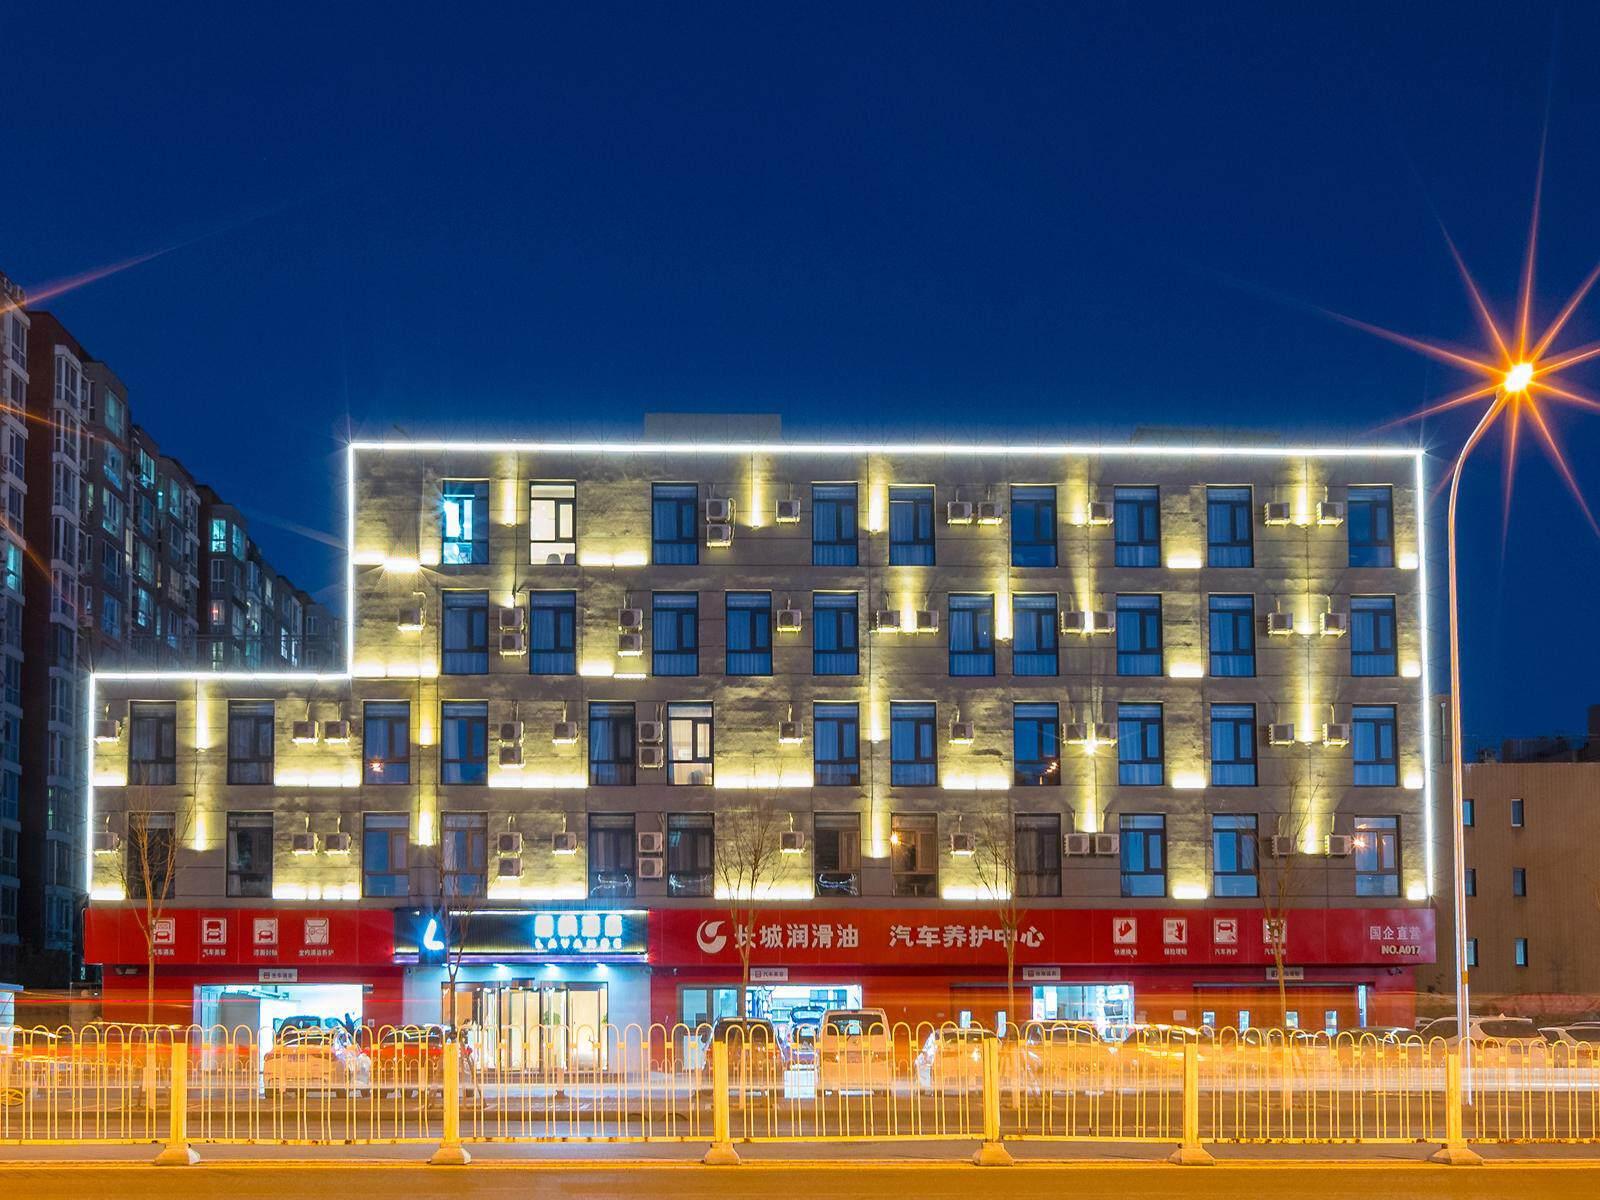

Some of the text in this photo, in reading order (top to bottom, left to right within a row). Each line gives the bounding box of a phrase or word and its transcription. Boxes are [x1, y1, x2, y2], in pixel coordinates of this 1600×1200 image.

[734, 923, 859, 949] 长城润滑油
[889, 925, 1045, 948] 汽车养护中心
[1370, 926, 1421, 940] 国企直营
[1381, 945, 1421, 955] NO.A017
